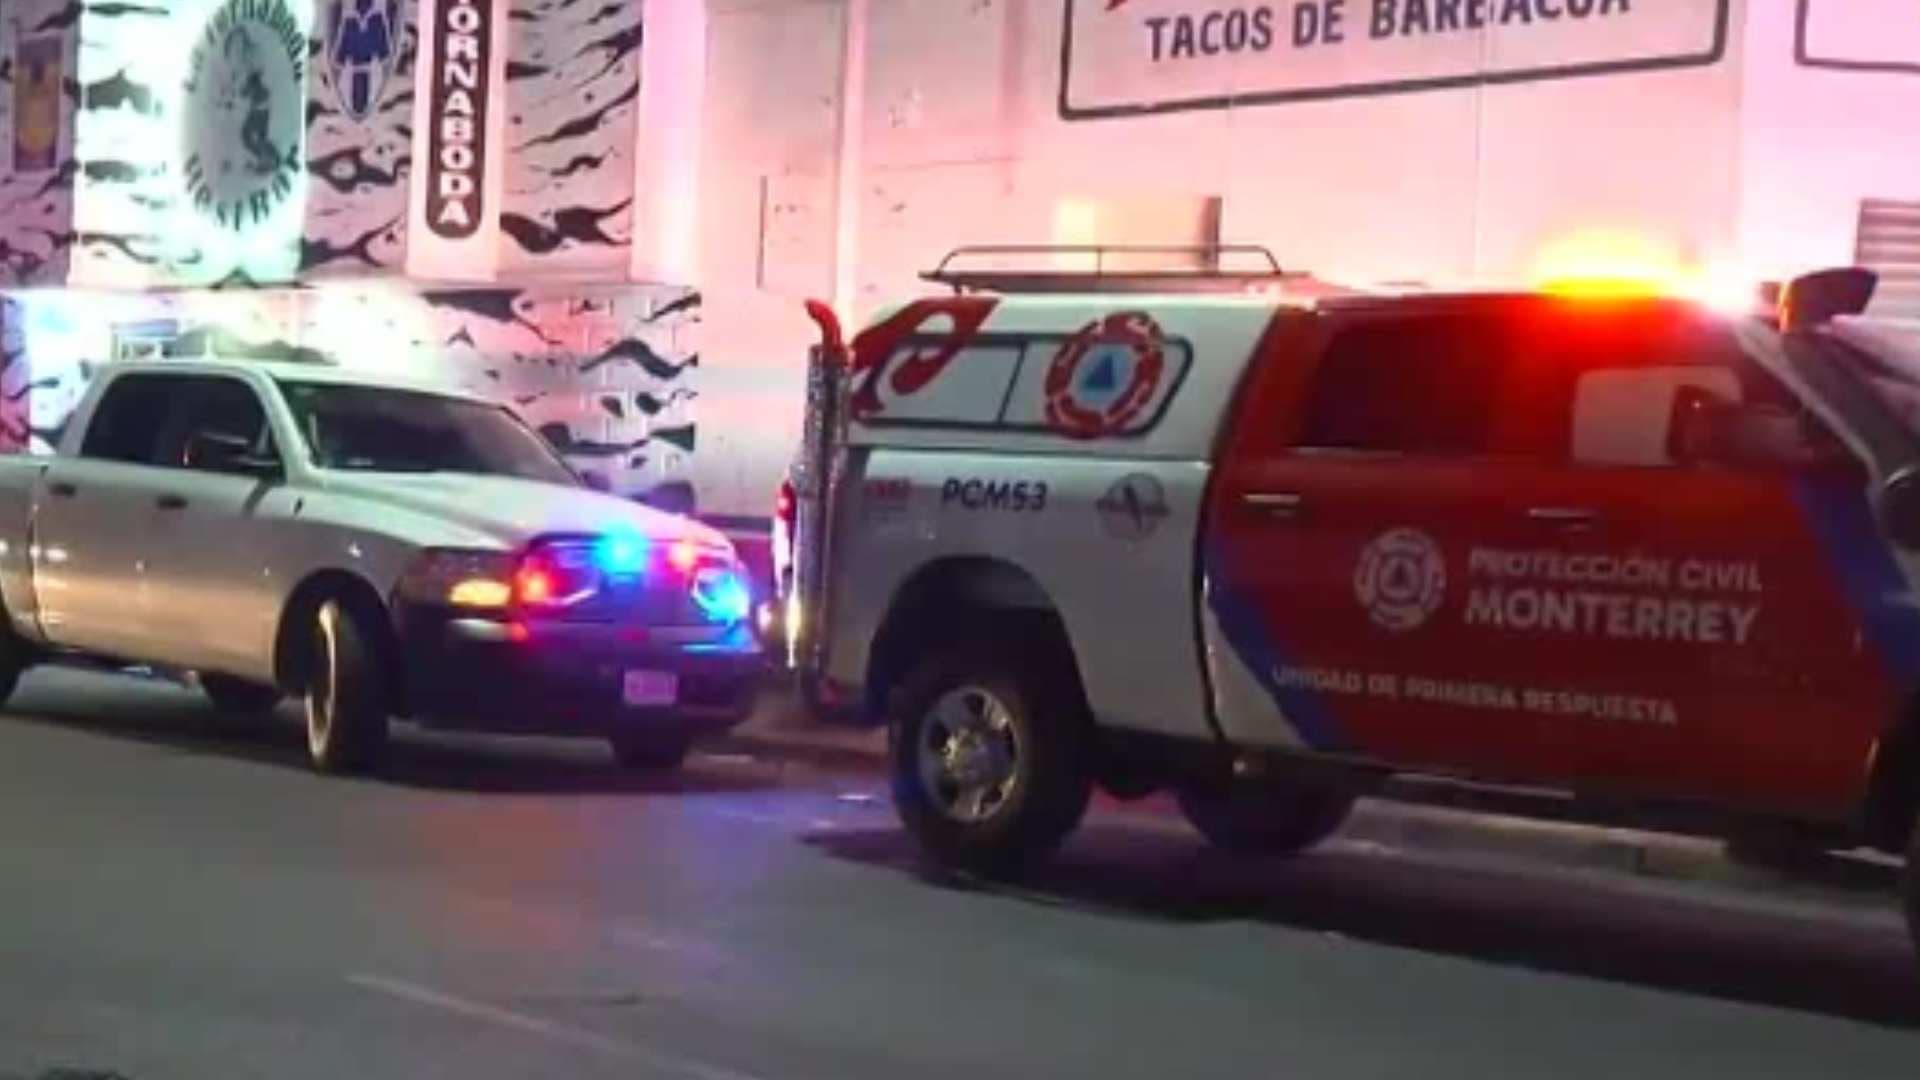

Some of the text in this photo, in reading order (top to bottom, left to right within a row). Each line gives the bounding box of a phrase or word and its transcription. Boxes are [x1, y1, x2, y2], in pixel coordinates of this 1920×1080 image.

[1145, 6, 1273, 62] TACOS
[1292, 0, 1345, 48] DE
[437, 0, 480, 225] ORNABODA
[940, 475, 1049, 512] PCM53
[1468, 545, 1762, 593] PROTECCIÓN CIVIL
[1463, 588, 1760, 645] MONTERREY
[1271, 663, 1679, 726] UNIDAD DE PRIMERA RESPUESTA
